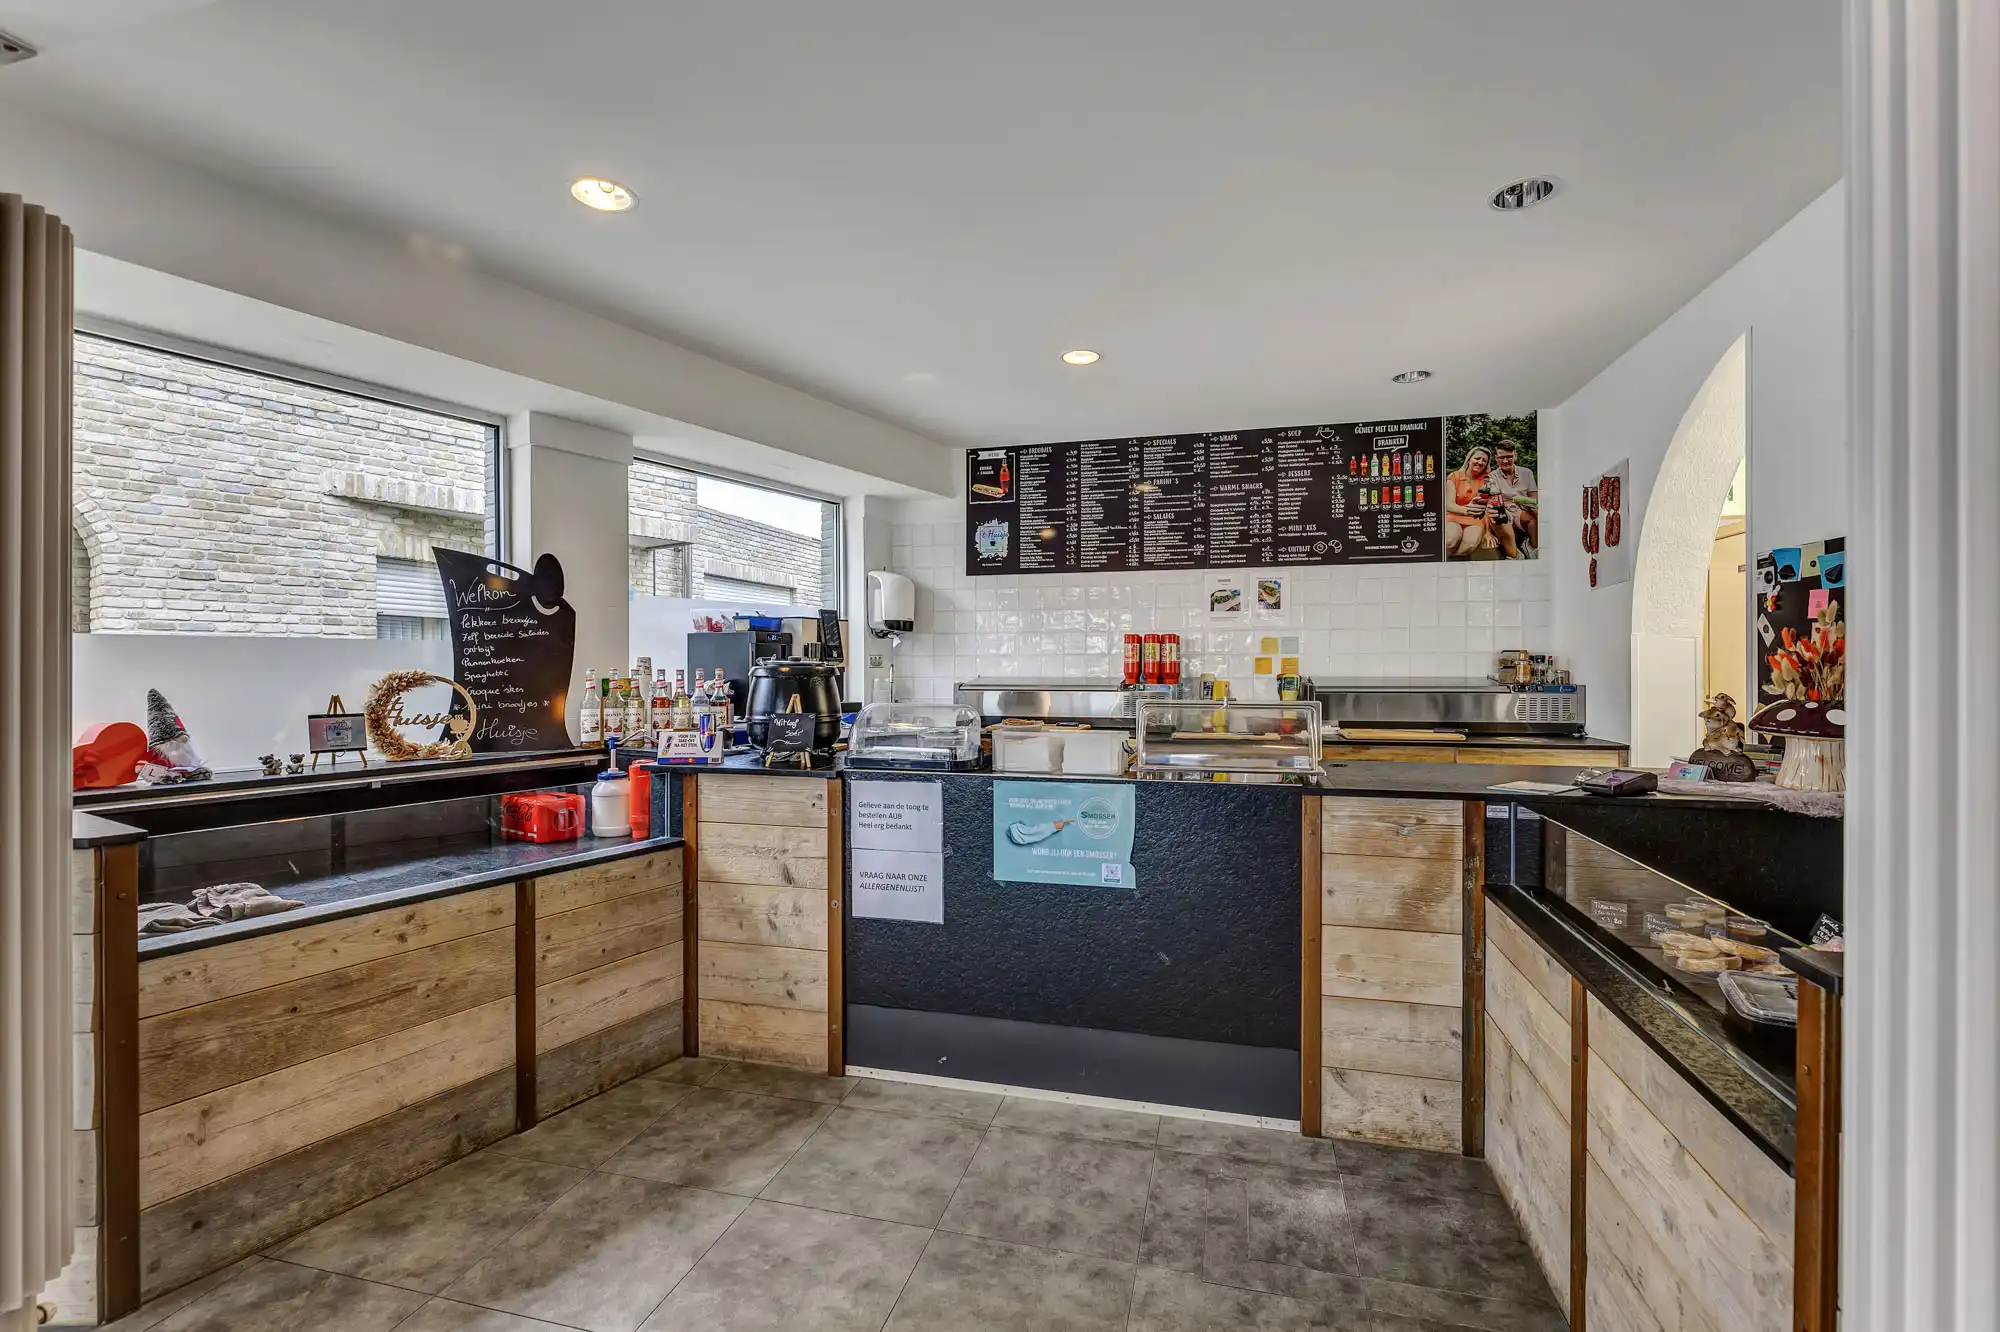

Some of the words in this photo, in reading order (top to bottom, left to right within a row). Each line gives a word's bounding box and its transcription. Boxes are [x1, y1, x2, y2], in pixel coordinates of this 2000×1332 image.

[1378, 438, 1405, 446] DRANKEN
[449, 576, 516, 607] Welkom
[502, 615, 538, 627] broodjes
[498, 699, 538, 713] broodjes
[858, 801, 881, 809] Gelieve
[906, 804, 920, 812] toog
[1032, 848, 1049, 856] WORD
[1060, 849, 1073, 857] OOK
[860, 871, 884, 879] VRAAG
[908, 874, 928, 882] ONZE
[860, 883, 925, 893] ALLERGENENLIJST!
